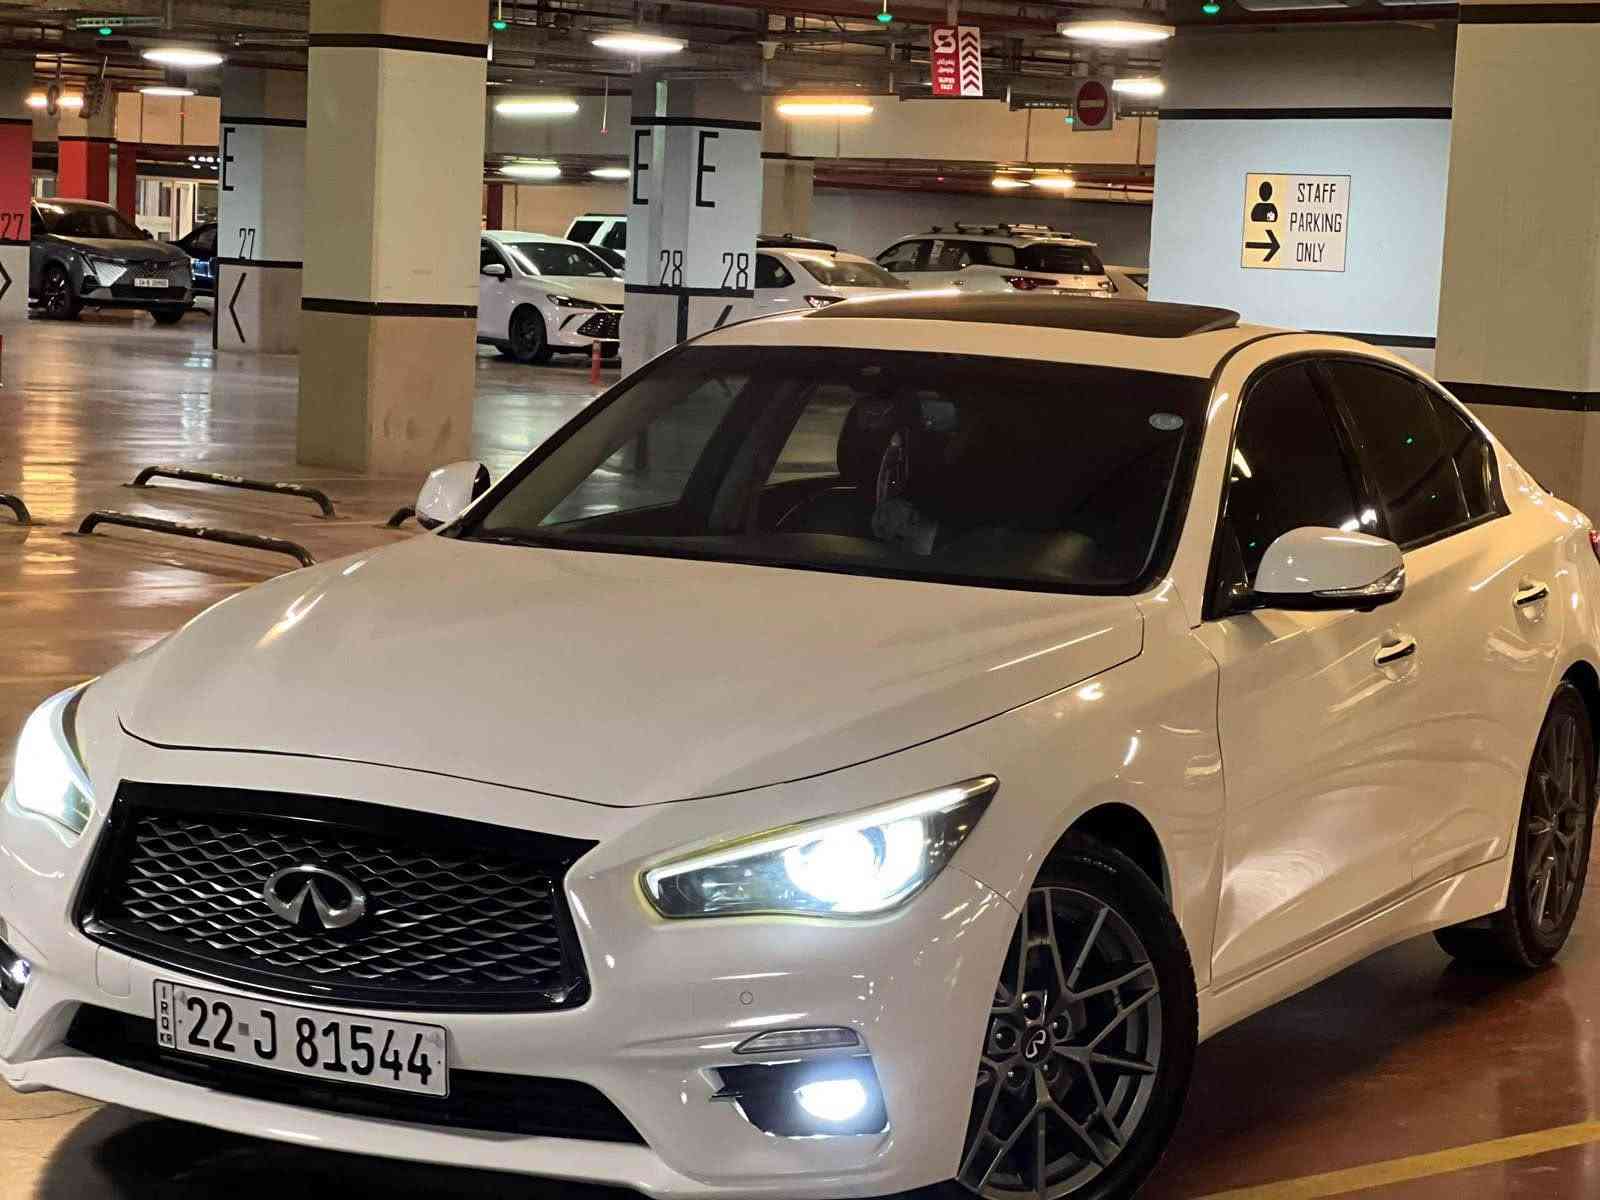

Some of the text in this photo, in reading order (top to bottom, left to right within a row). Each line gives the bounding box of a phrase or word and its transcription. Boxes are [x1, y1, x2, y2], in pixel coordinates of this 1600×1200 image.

[223, 128, 235, 191] E
[633, 130, 650, 204] E
[696, 131, 719, 208] E
[1297, 183, 1336, 203] STAFF
[1290, 212, 1342, 232] PARKING
[239, 228, 255, 260] 27
[1296, 242, 1325, 263] ONLY
[660, 250, 682, 287] 28
[721, 252, 748, 289] 28
[296, 1017, 432, 1085] 81544
